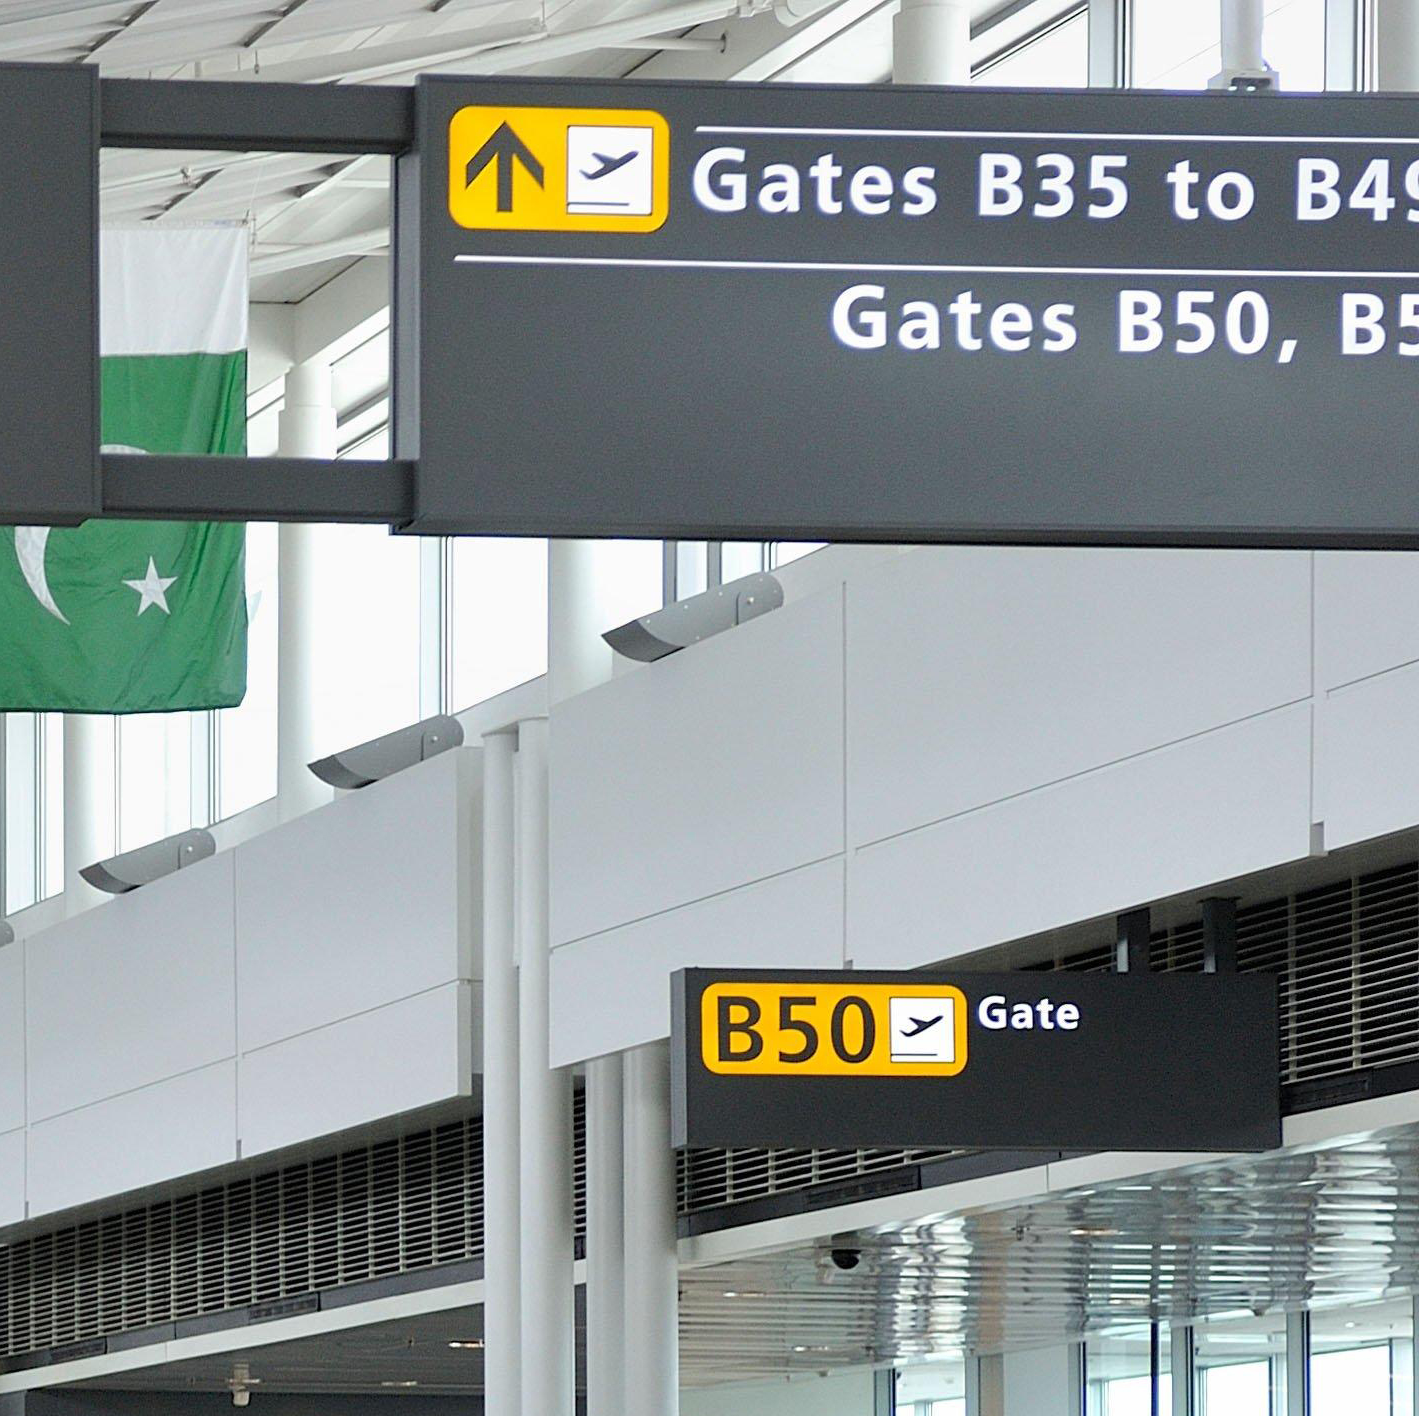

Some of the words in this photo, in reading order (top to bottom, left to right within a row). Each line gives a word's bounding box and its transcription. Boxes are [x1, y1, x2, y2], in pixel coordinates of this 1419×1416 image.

[692, 146, 938, 216] Gates
[978, 152, 1129, 219] B35
[1166, 159, 1255, 221] to
[831, 283, 1078, 352] Gates
[1118, 289, 1298, 364] B50,
[716, 995, 876, 1064] B50
[977, 994, 1081, 1031] Gate
